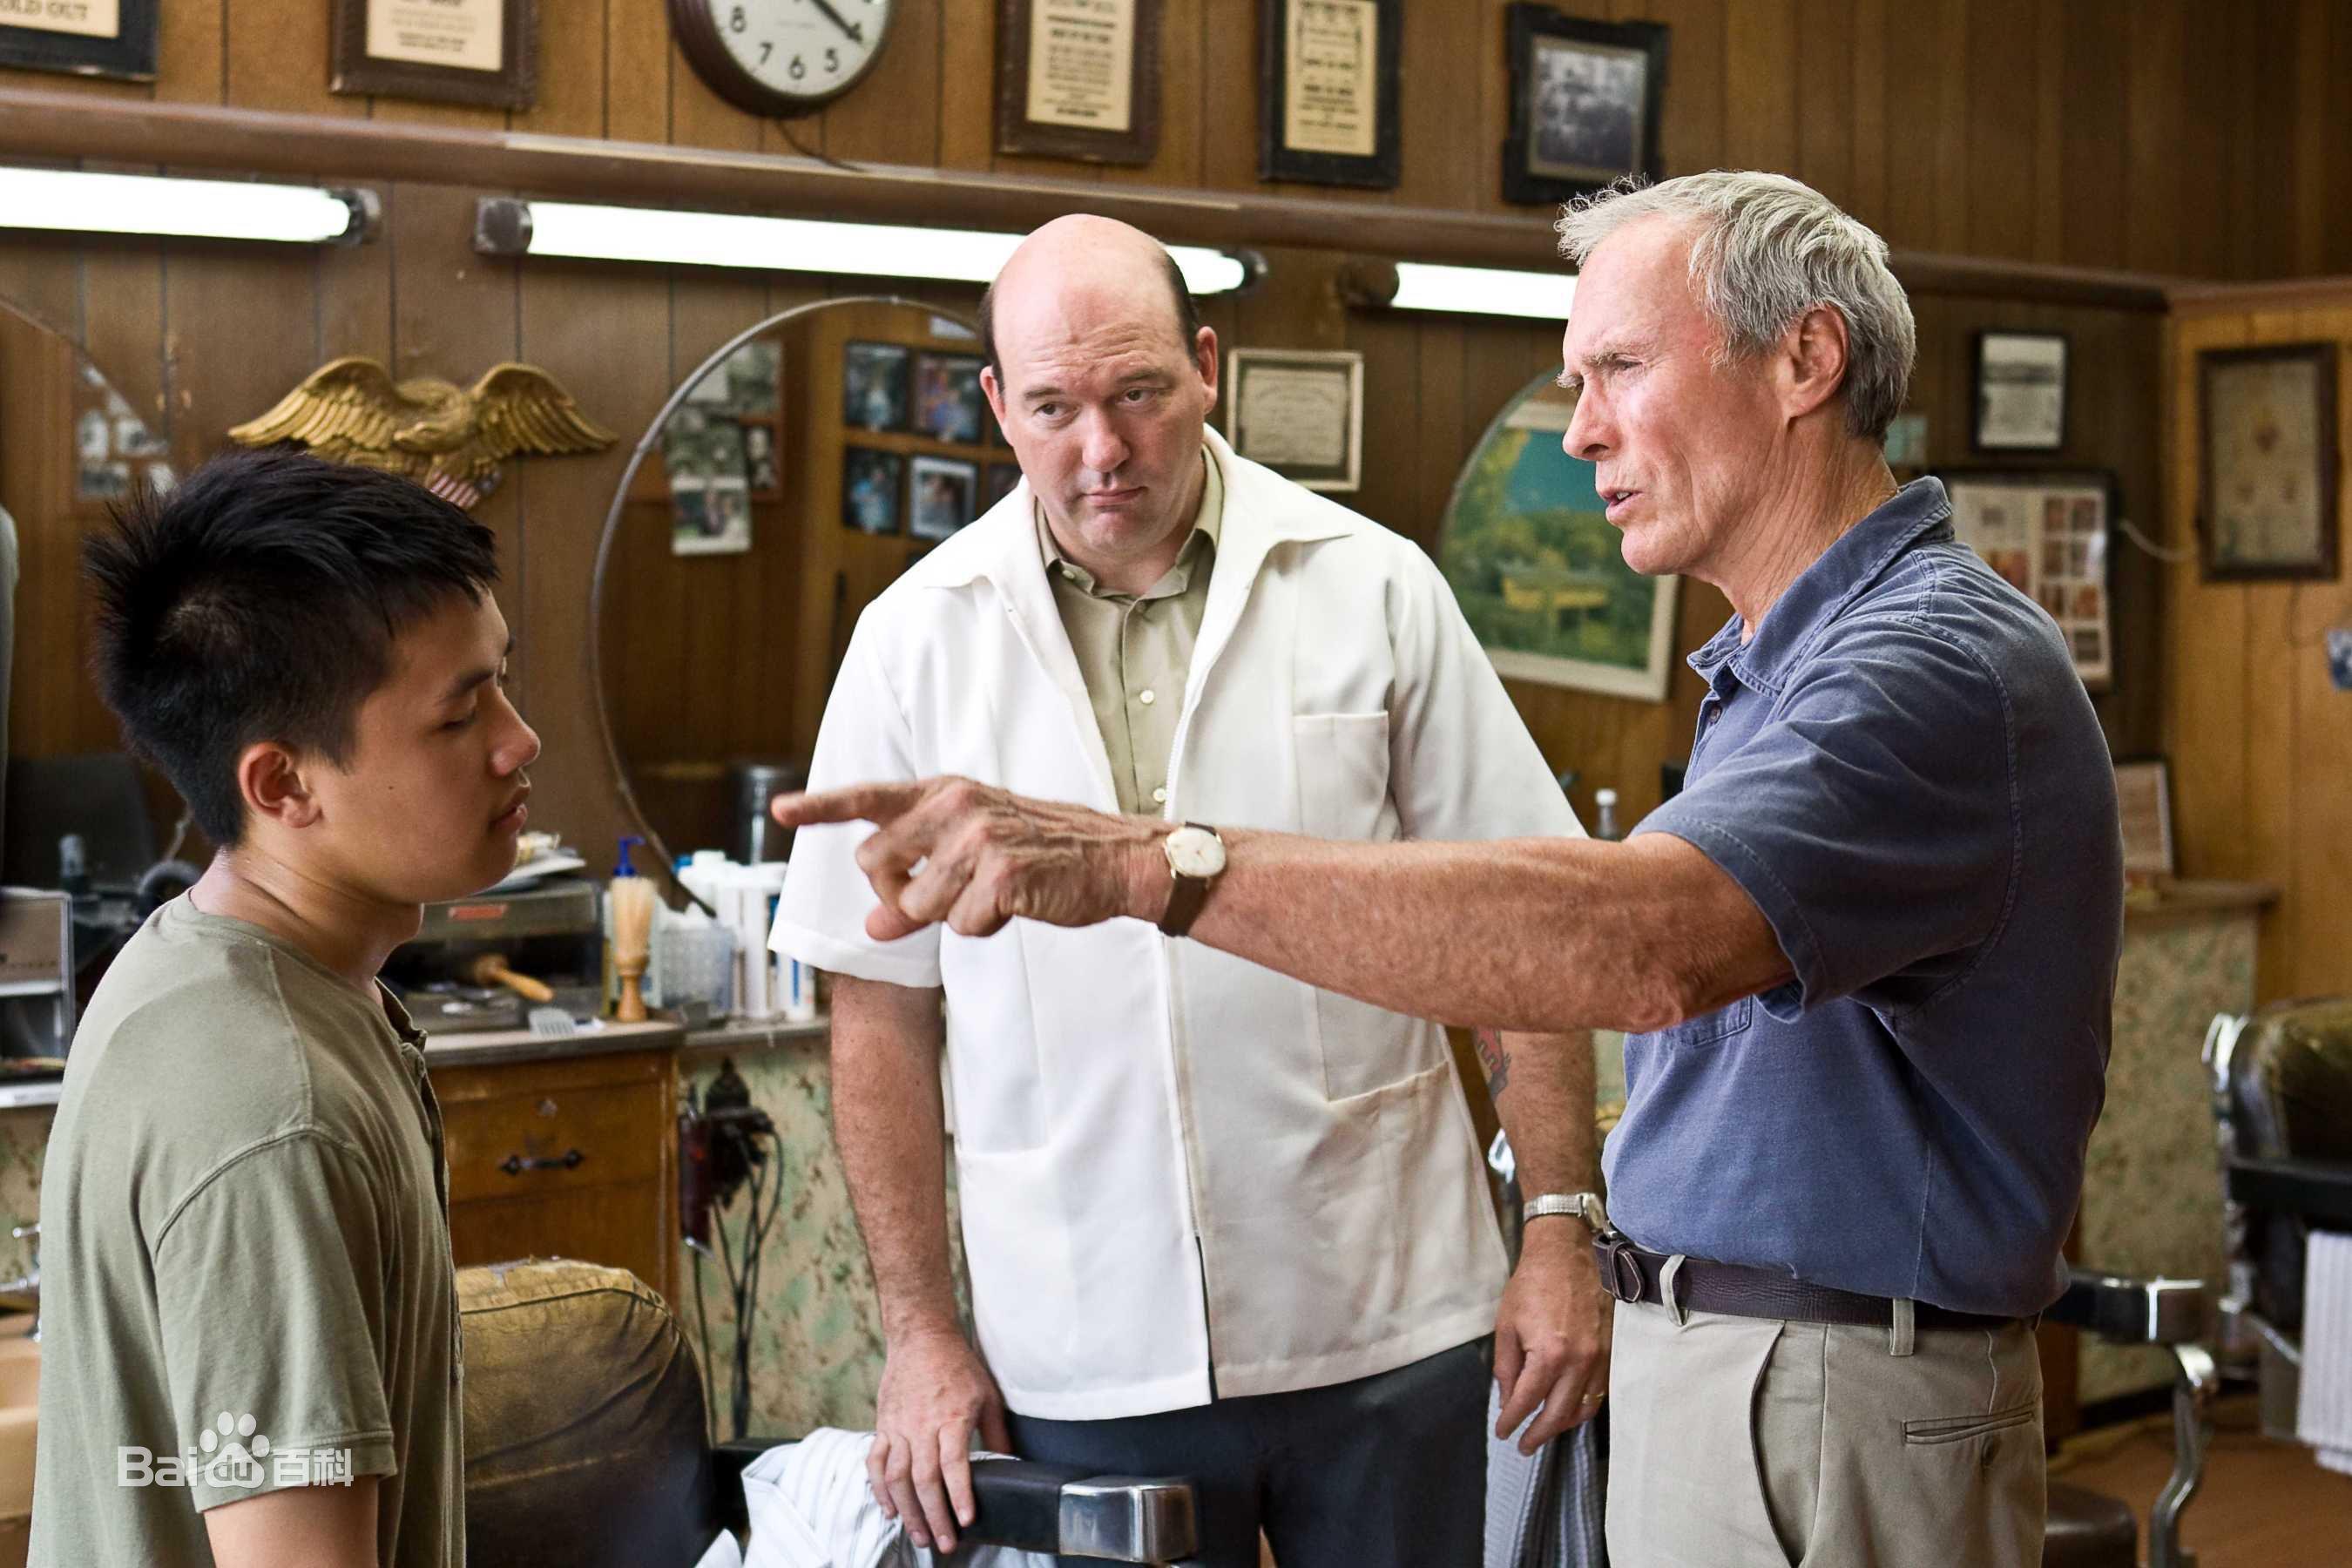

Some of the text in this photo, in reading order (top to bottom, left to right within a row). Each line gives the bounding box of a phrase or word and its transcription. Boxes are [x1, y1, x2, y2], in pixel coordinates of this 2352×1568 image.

[730, 6, 747, 33] 8
[759, 42, 774, 64] 7
[825, 48, 838, 72] 5
[788, 54, 805, 80] 6
